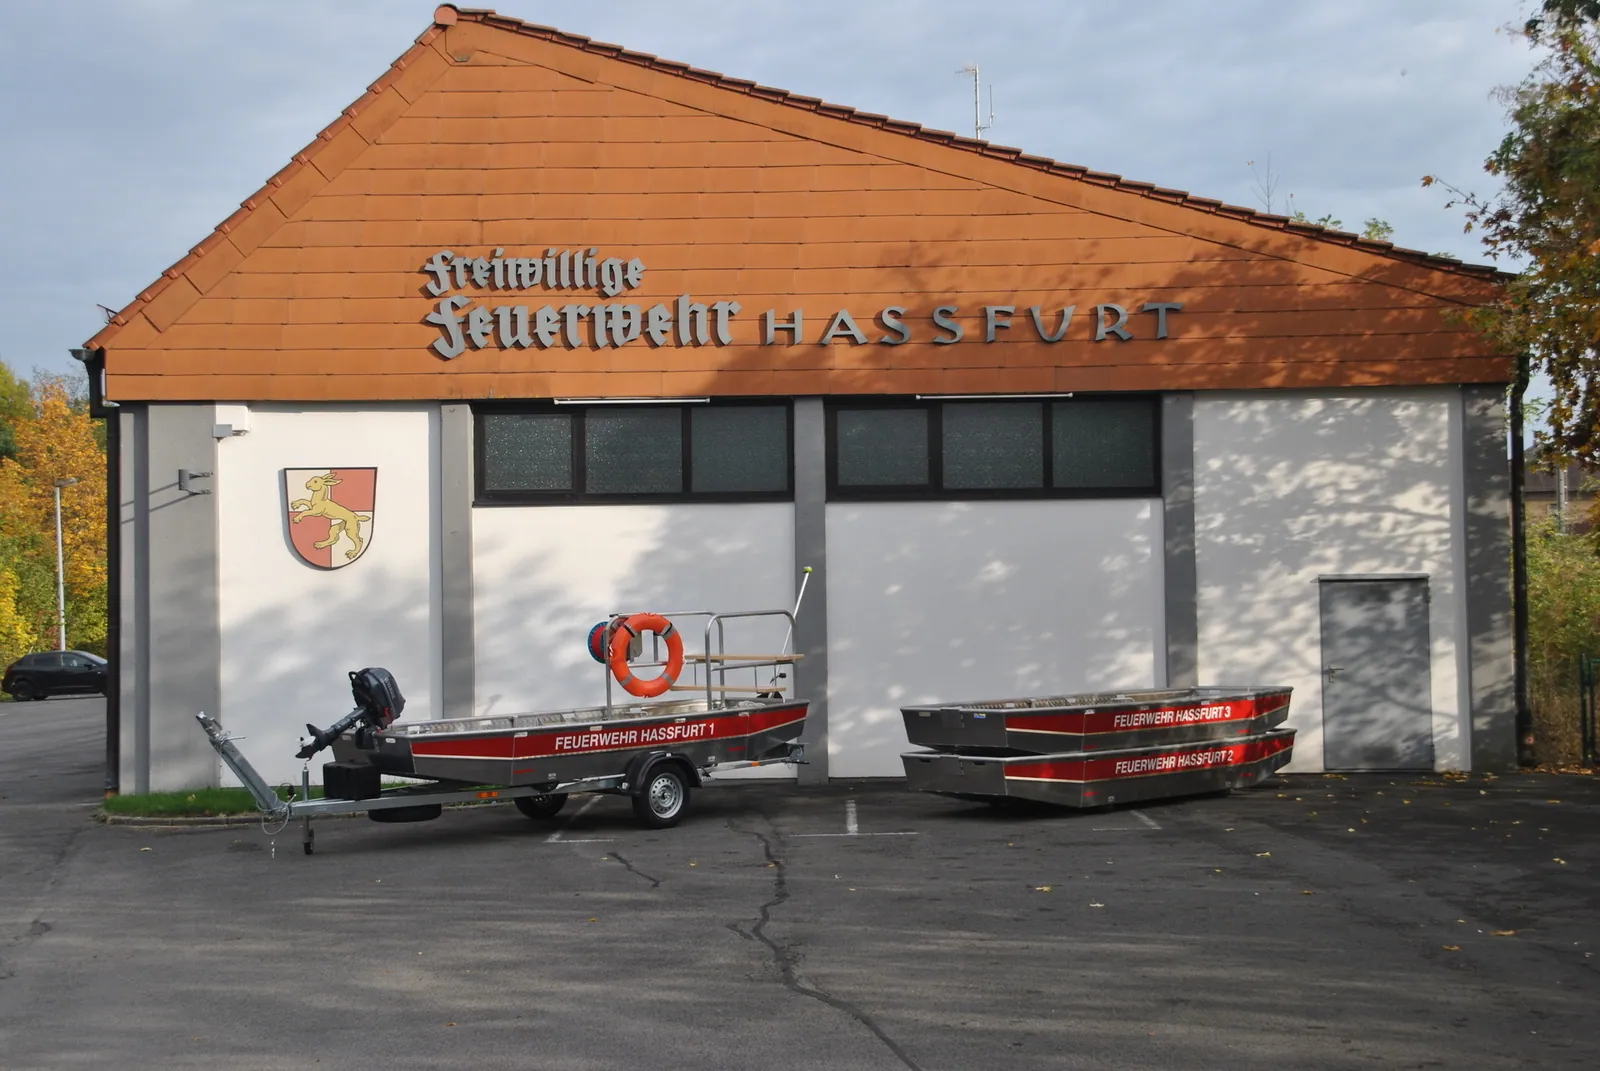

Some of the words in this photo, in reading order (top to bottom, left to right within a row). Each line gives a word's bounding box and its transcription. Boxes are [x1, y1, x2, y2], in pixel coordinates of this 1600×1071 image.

[426, 294, 742, 360] Feuerwehr
[764, 302, 1183, 346] HASSFURT
[1114, 711, 1174, 727] FEUERWEHR
[1175, 706, 1224, 722] HASSFURT
[1224, 706, 1231, 718] 3
[555, 730, 637, 750] FEUERWEHR
[641, 723, 706, 742] HASSFURT
[709, 723, 715, 735] 1
[1115, 756, 1175, 774] FEUERWEHR
[1178, 750, 1227, 767] HASSFURT
[1227, 750, 1234, 761] 2
